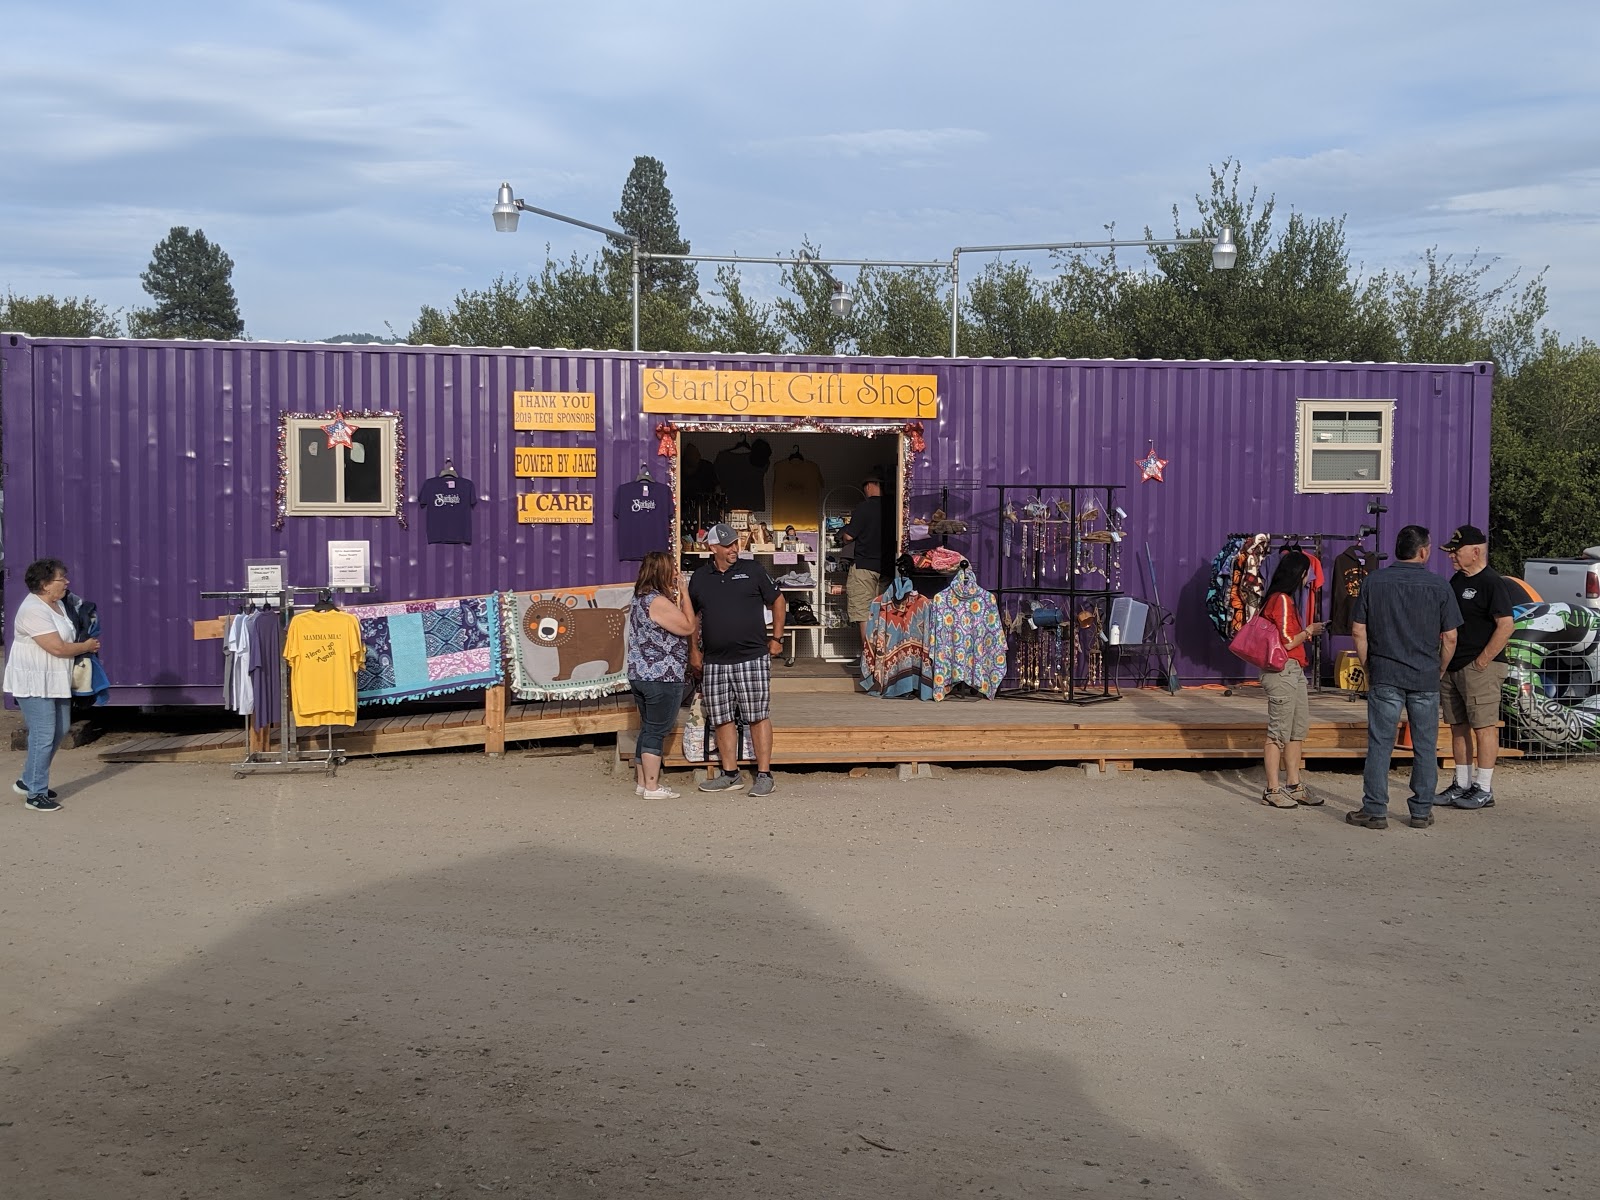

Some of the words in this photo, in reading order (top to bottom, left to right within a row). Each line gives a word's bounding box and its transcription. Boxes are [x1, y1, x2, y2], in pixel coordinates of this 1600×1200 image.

[646, 370, 780, 411] Starlight
[788, 374, 849, 404] Gift
[857, 374, 935, 417] Shop
[518, 395, 557, 408] THANK
[561, 396, 590, 409] YOU
[515, 412, 532, 423] 2019
[534, 412, 554, 423] TECH
[556, 413, 595, 424] SPONSORS
[515, 454, 553, 473] POWER
[557, 454, 570, 473] BY
[572, 454, 597, 473] JAKE
[519, 494, 528, 512] I
[535, 494, 593, 512] CARE
[305, 648, 322, 660] Here
